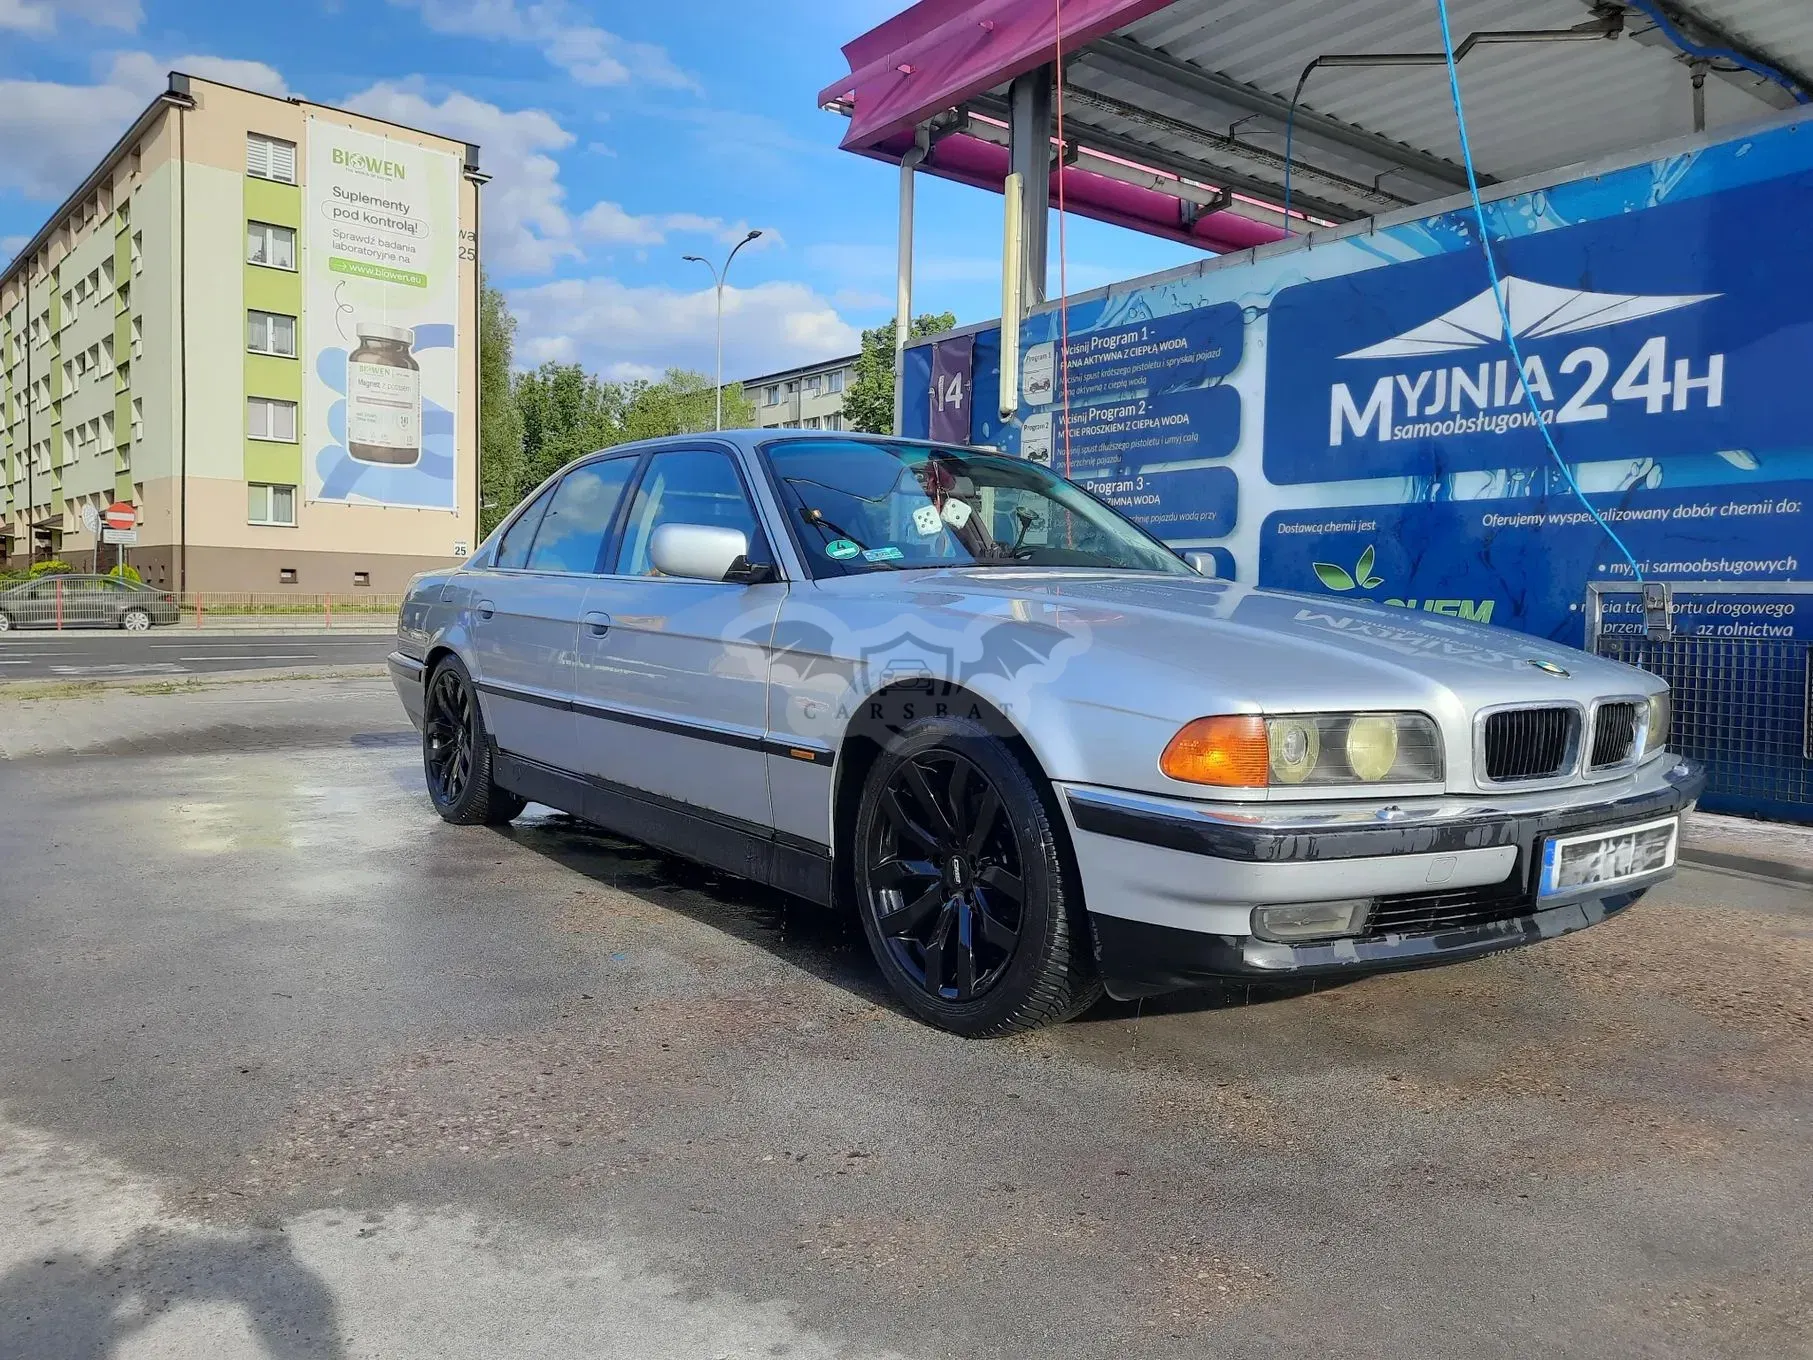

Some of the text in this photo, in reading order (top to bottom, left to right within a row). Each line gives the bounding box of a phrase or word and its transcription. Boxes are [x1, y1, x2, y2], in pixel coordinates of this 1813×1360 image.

[332, 148, 405, 180] BIOWEN
[332, 186, 410, 215] Suplementy
[333, 208, 418, 235] pod kontrolą!
[332, 228, 416, 253] Sprawdź badania
[332, 240, 411, 264] laboratoryjne na
[458, 246, 476, 262] 25
[349, 264, 422, 284] www.biowen.eu
[1091, 332, 1138, 350] Program
[1141, 327, 1148, 340] 1
[1060, 338, 1188, 371] PANA AKTYWNA Z CIEPŁĄ WODĄ
[1196, 348, 1222, 362] pojazd
[938, 371, 964, 412] 14
[1088, 404, 1136, 422] Program
[1138, 400, 1146, 415] 2
[1057, 413, 1190, 439] MCIE PROSZKIEM Z CIEPŁĄ WODĄ
[1392, 408, 1555, 440] samoobsługowa
[1130, 437, 1160, 449] pistoletu
[1086, 480, 1134, 496] Program
[1136, 476, 1144, 490] 3
[1133, 494, 1160, 505] WODĄ
[1150, 512, 1178, 524] pojazdu
[1199, 511, 1217, 521] przy
[1482, 512, 1546, 527] Oferujemy
[1672, 502, 1718, 519] dobór
[1720, 499, 1773, 516] chemii
[1775, 497, 1802, 513] do:
[1277, 519, 1377, 534] Dostawcą chemii jest
[454, 546, 467, 556] 25
[1652, 555, 1798, 575] samoobsługowych
[1706, 599, 1795, 618] drogowego
[1717, 621, 1794, 637] rolnictwa
